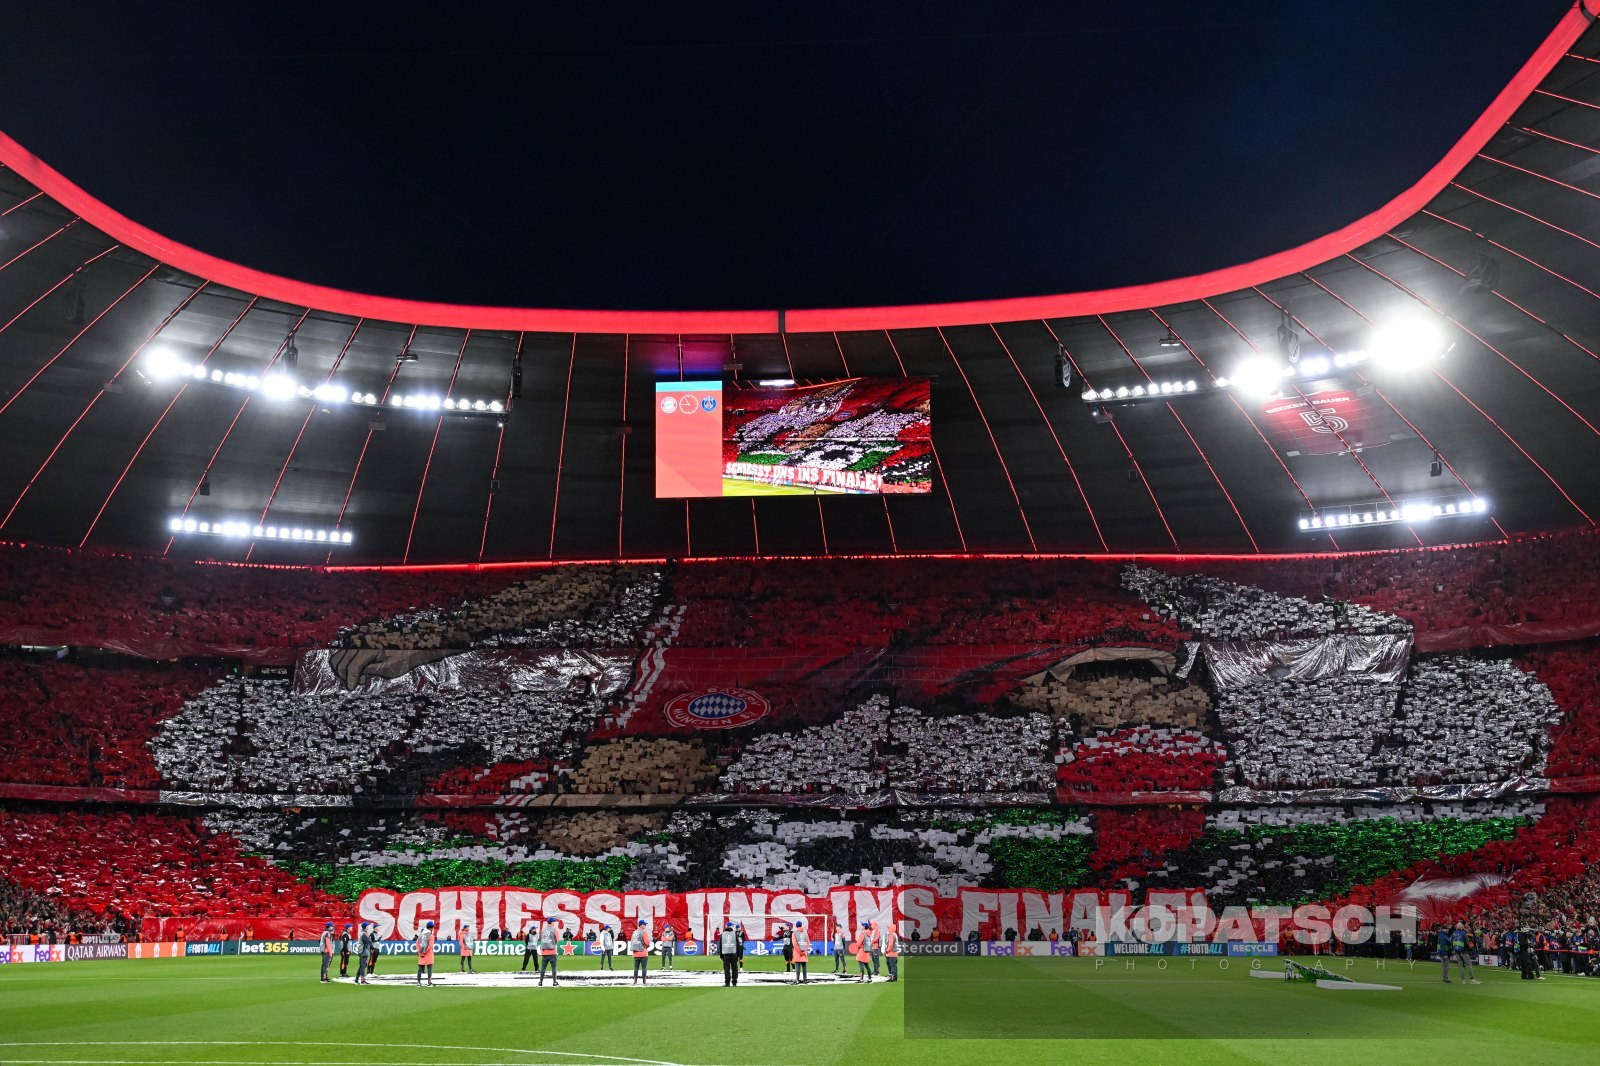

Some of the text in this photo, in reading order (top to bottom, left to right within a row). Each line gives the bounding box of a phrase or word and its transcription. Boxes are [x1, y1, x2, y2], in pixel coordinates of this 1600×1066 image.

[1299, 407, 1349, 434] 5
[797, 466, 820, 482] INS
[359, 890, 668, 941] SCHIESST
[686, 891, 808, 941] UNS
[831, 889, 937, 941] INS
[0, 945, 24, 963] edEx
[35, 944, 61, 962] FedEx
[68, 944, 126, 961] QATAR AIRWAYS
[242, 942, 289, 953] bet365
[897, 942, 957, 953] stercard
[986, 941, 1033, 956] FedEx
[1114, 943, 1148, 954] WELCOME
[1180, 943, 1223, 954] #FOOTBALL
[1232, 944, 1274, 952] RECYCLE
